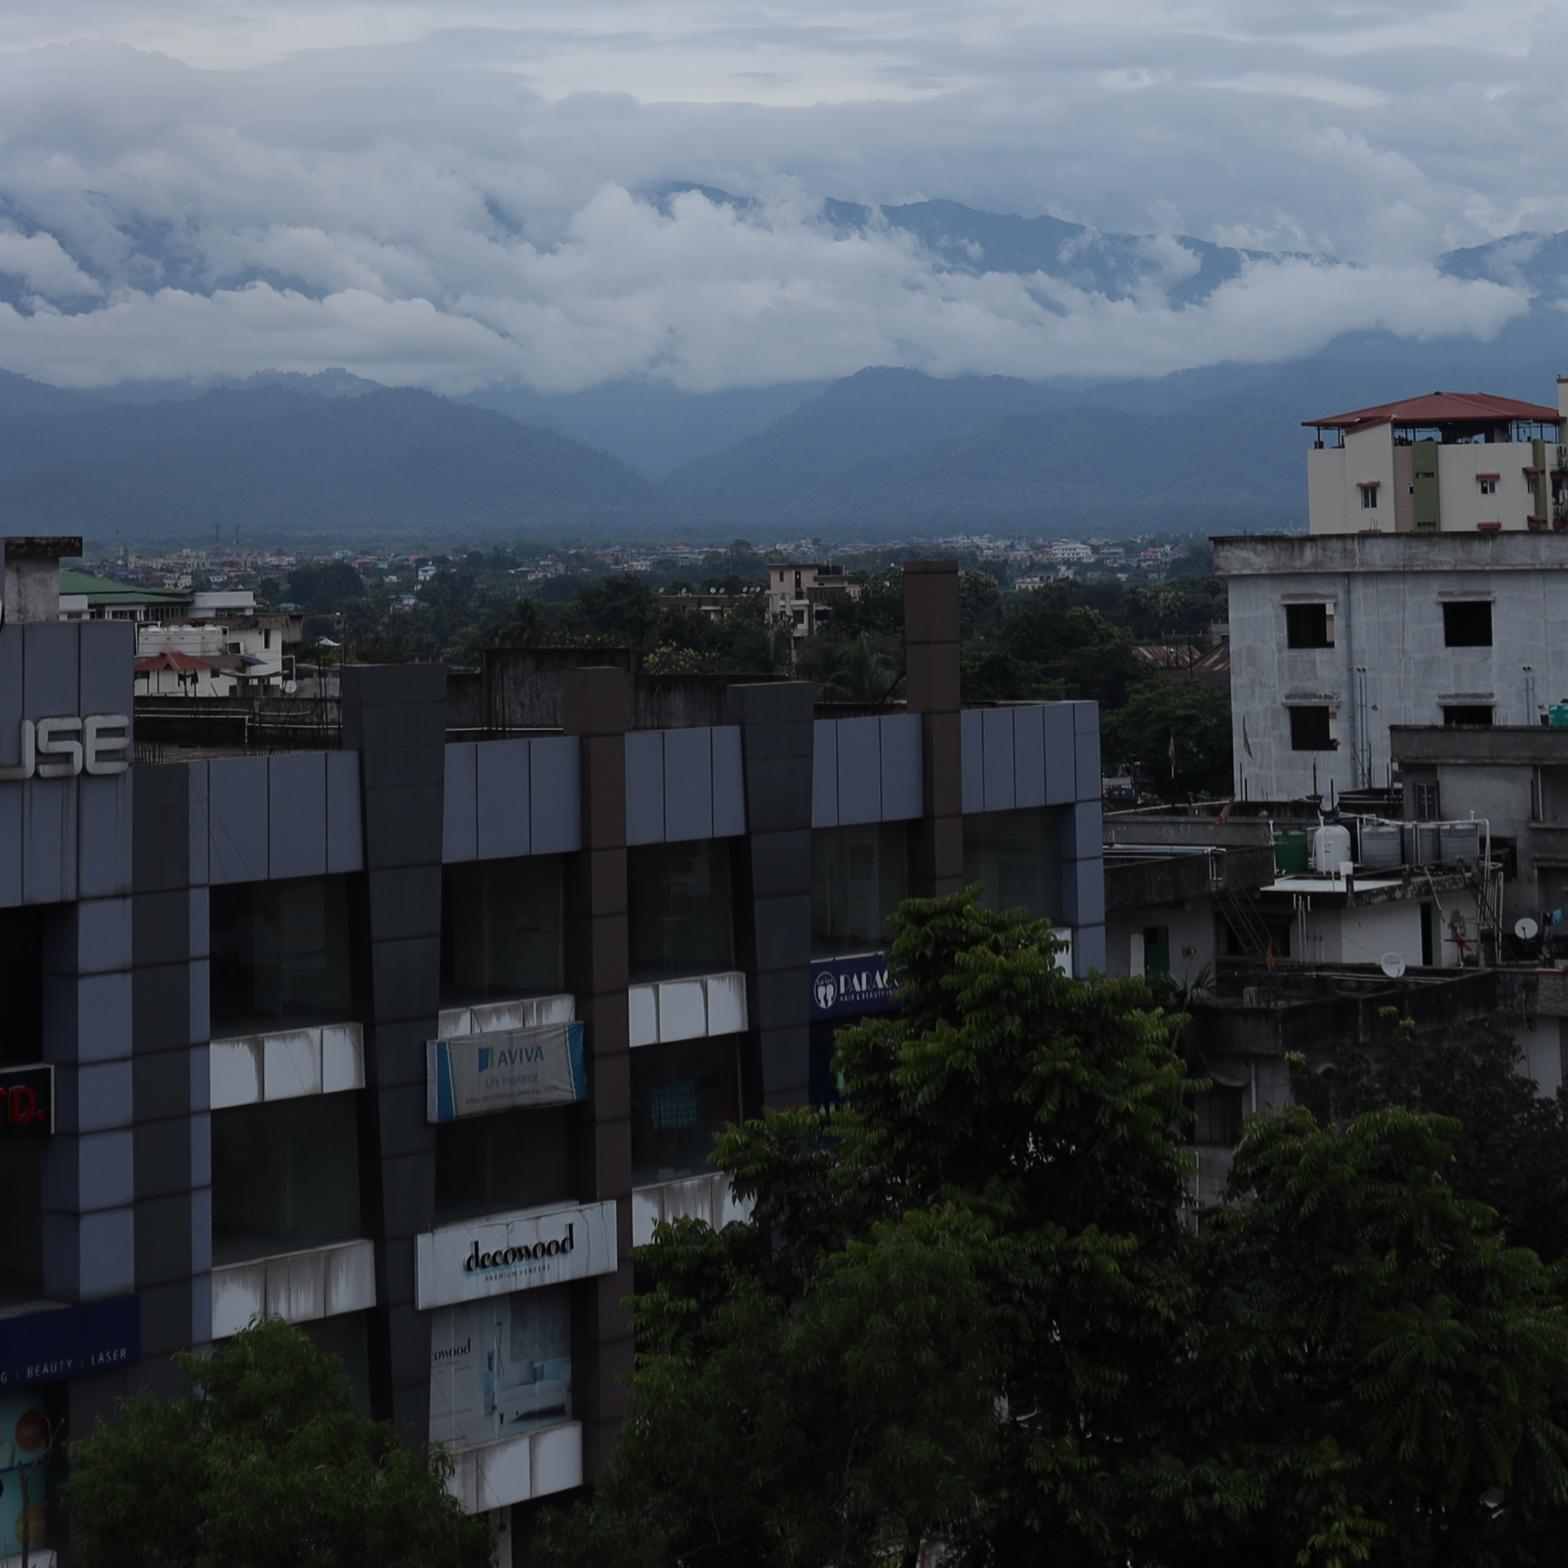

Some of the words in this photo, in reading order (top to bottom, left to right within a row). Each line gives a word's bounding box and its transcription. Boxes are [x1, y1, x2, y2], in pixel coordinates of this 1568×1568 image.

[839, 968, 901, 994] PARA
[497, 1045, 544, 1067] AVIVA
[464, 1223, 574, 1272] decowood
[26, 1358, 73, 1379] BEAUTY
[91, 1348, 127, 1367] LASER
